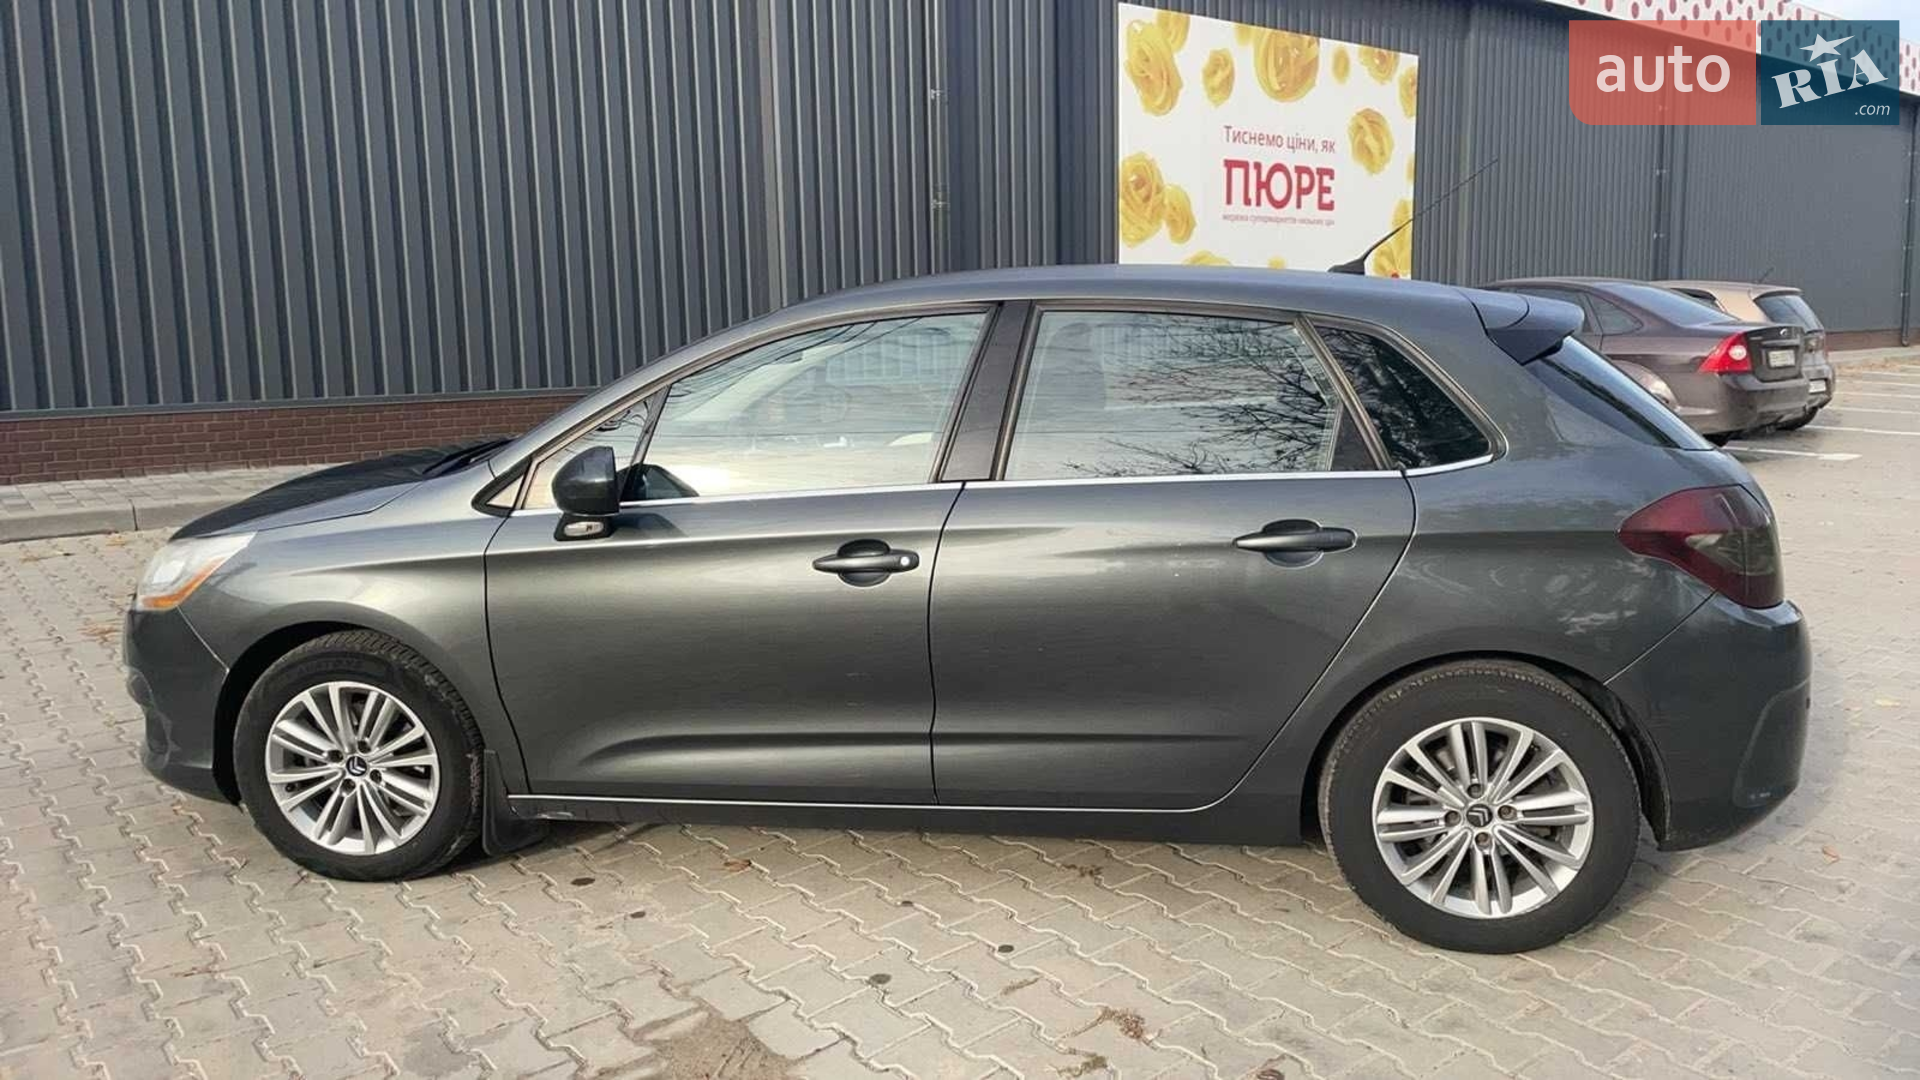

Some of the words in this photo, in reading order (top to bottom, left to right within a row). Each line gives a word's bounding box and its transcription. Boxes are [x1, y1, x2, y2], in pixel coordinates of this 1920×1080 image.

[1223, 125, 1284, 149] Тиснемо
[1286, 132, 1319, 154] ціни,
[1320, 139, 1336, 154] як
[1223, 158, 1335, 211] ПЮРЕ
